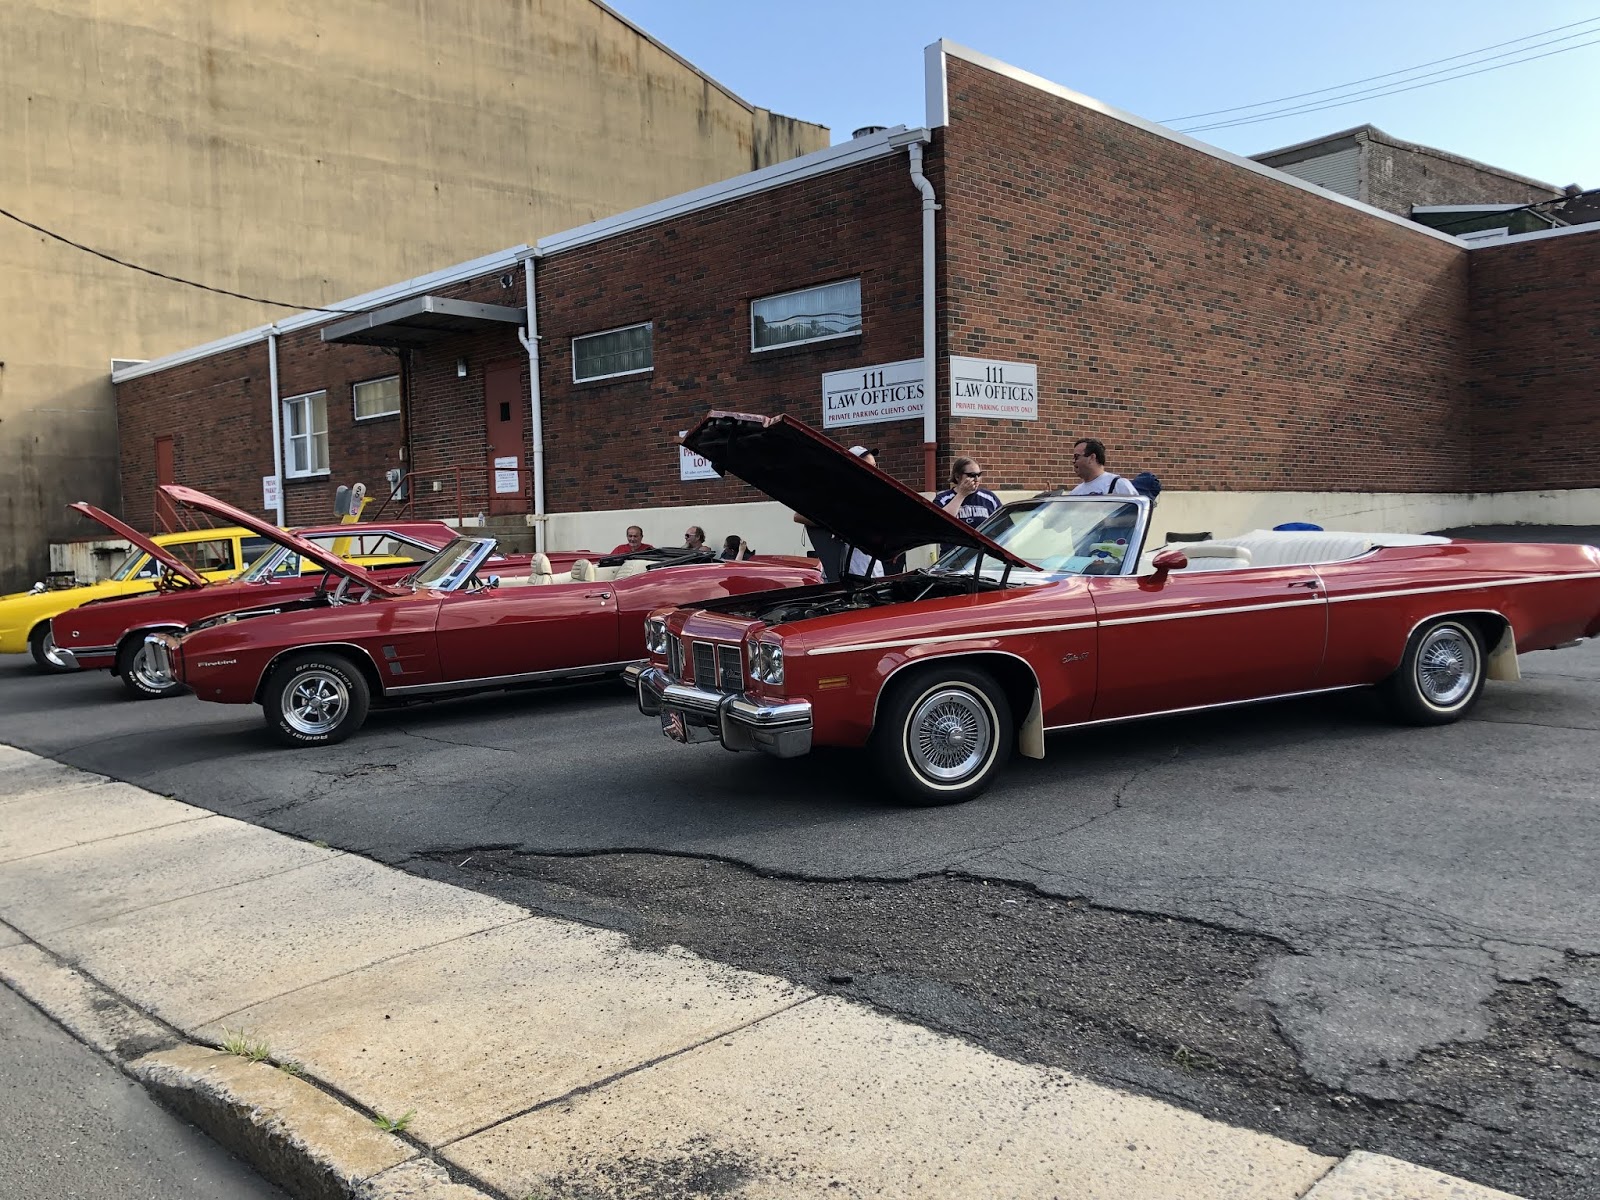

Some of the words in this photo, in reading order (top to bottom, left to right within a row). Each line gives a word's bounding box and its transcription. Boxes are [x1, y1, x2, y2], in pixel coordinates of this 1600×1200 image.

[862, 370, 885, 390] 111
[986, 365, 1004, 384] 111
[828, 393, 858, 410] LAW
[861, 384, 924, 405] OFFICES
[955, 382, 982, 397] LAW
[985, 384, 1034, 402] OFFICES
[828, 413, 850, 421] PRIVATE
[852, 409, 879, 419] PARKING
[881, 406, 905, 415] CLIENTS
[907, 404, 924, 412] ONLY
[955, 402, 976, 410] PRIVATE
[977, 404, 999, 412] PARKING
[1000, 405, 1020, 413] CLIENTS
